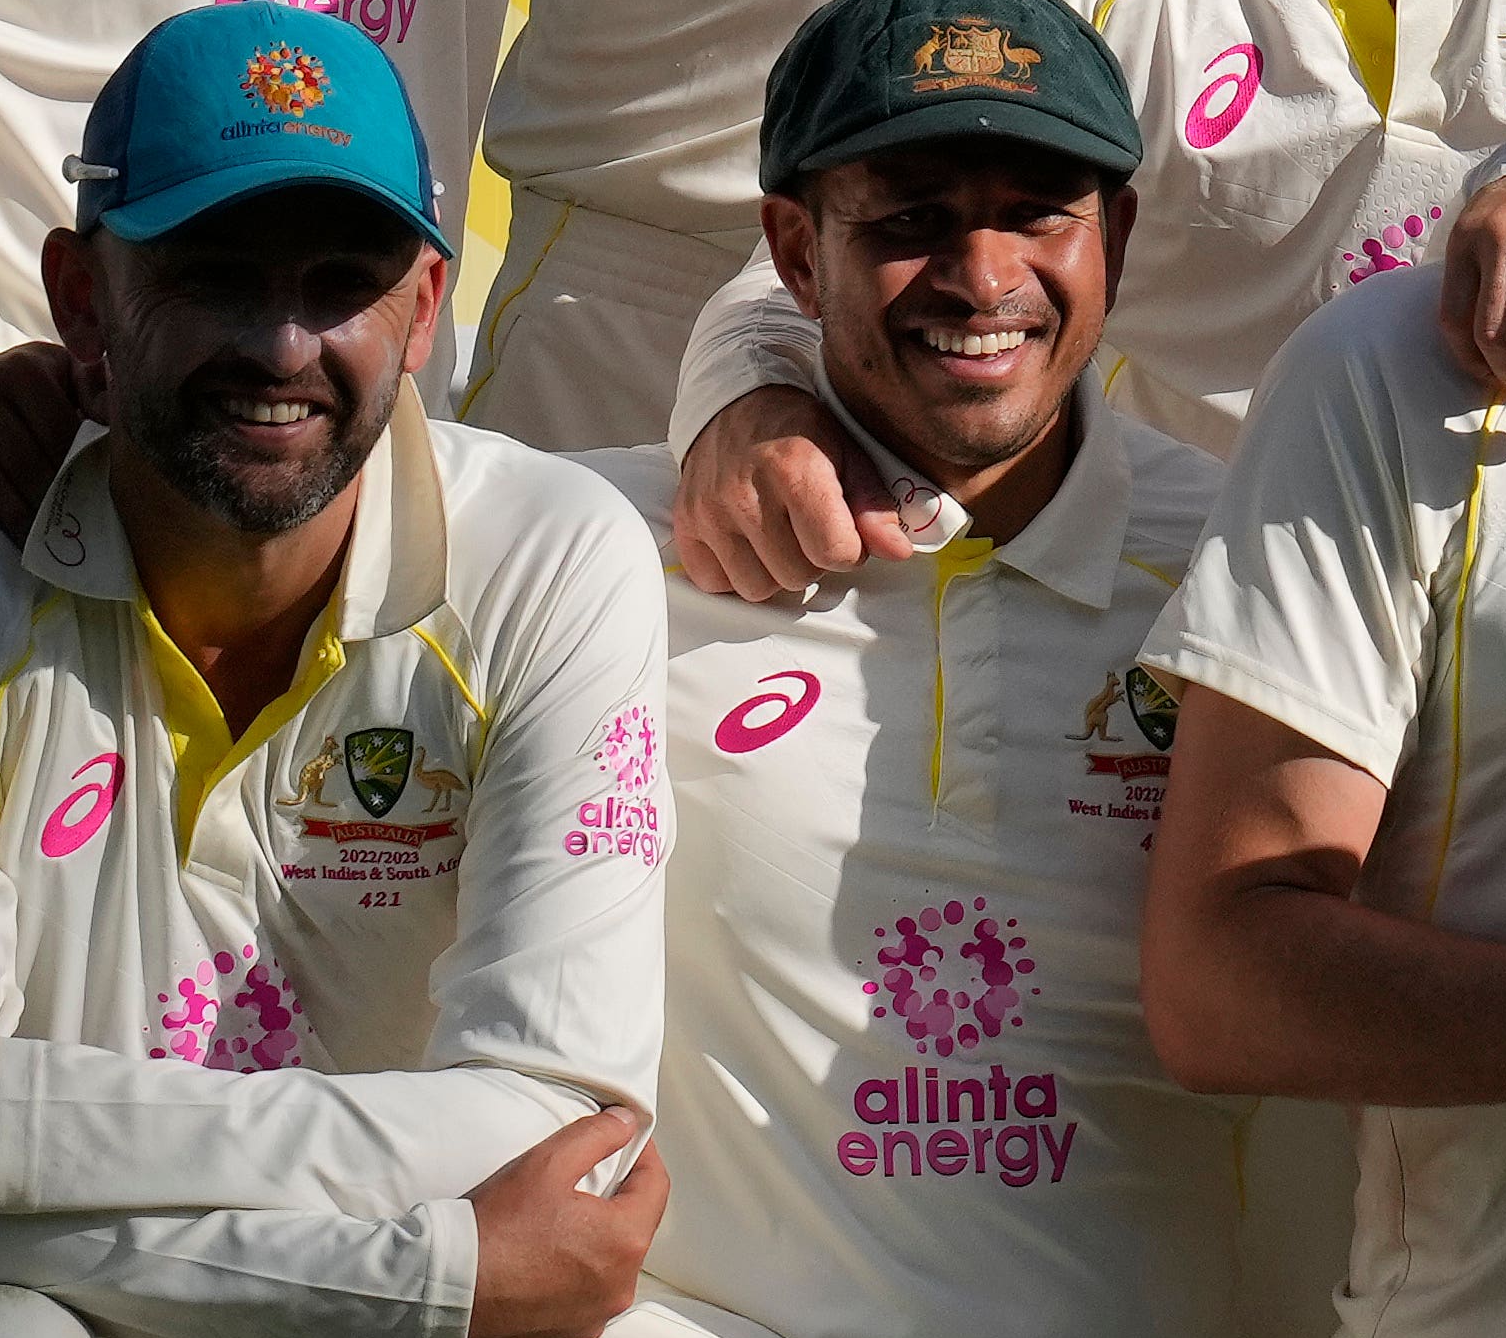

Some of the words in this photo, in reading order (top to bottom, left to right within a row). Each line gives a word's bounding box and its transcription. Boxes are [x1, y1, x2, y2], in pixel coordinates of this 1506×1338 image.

[1068, 799, 1103, 817] West
[1107, 802, 1149, 821] Indies
[336, 824, 424, 846] AUSTRALIA
[340, 849, 422, 865] 2022/2023
[281, 865, 318, 880] West
[322, 864, 367, 881] Indies
[369, 866, 384, 881] &
[387, 863, 432, 881] South
[359, 891, 404, 910] 421
[853, 1064, 1060, 1125] alinta
[836, 1121, 1080, 1188] energy
